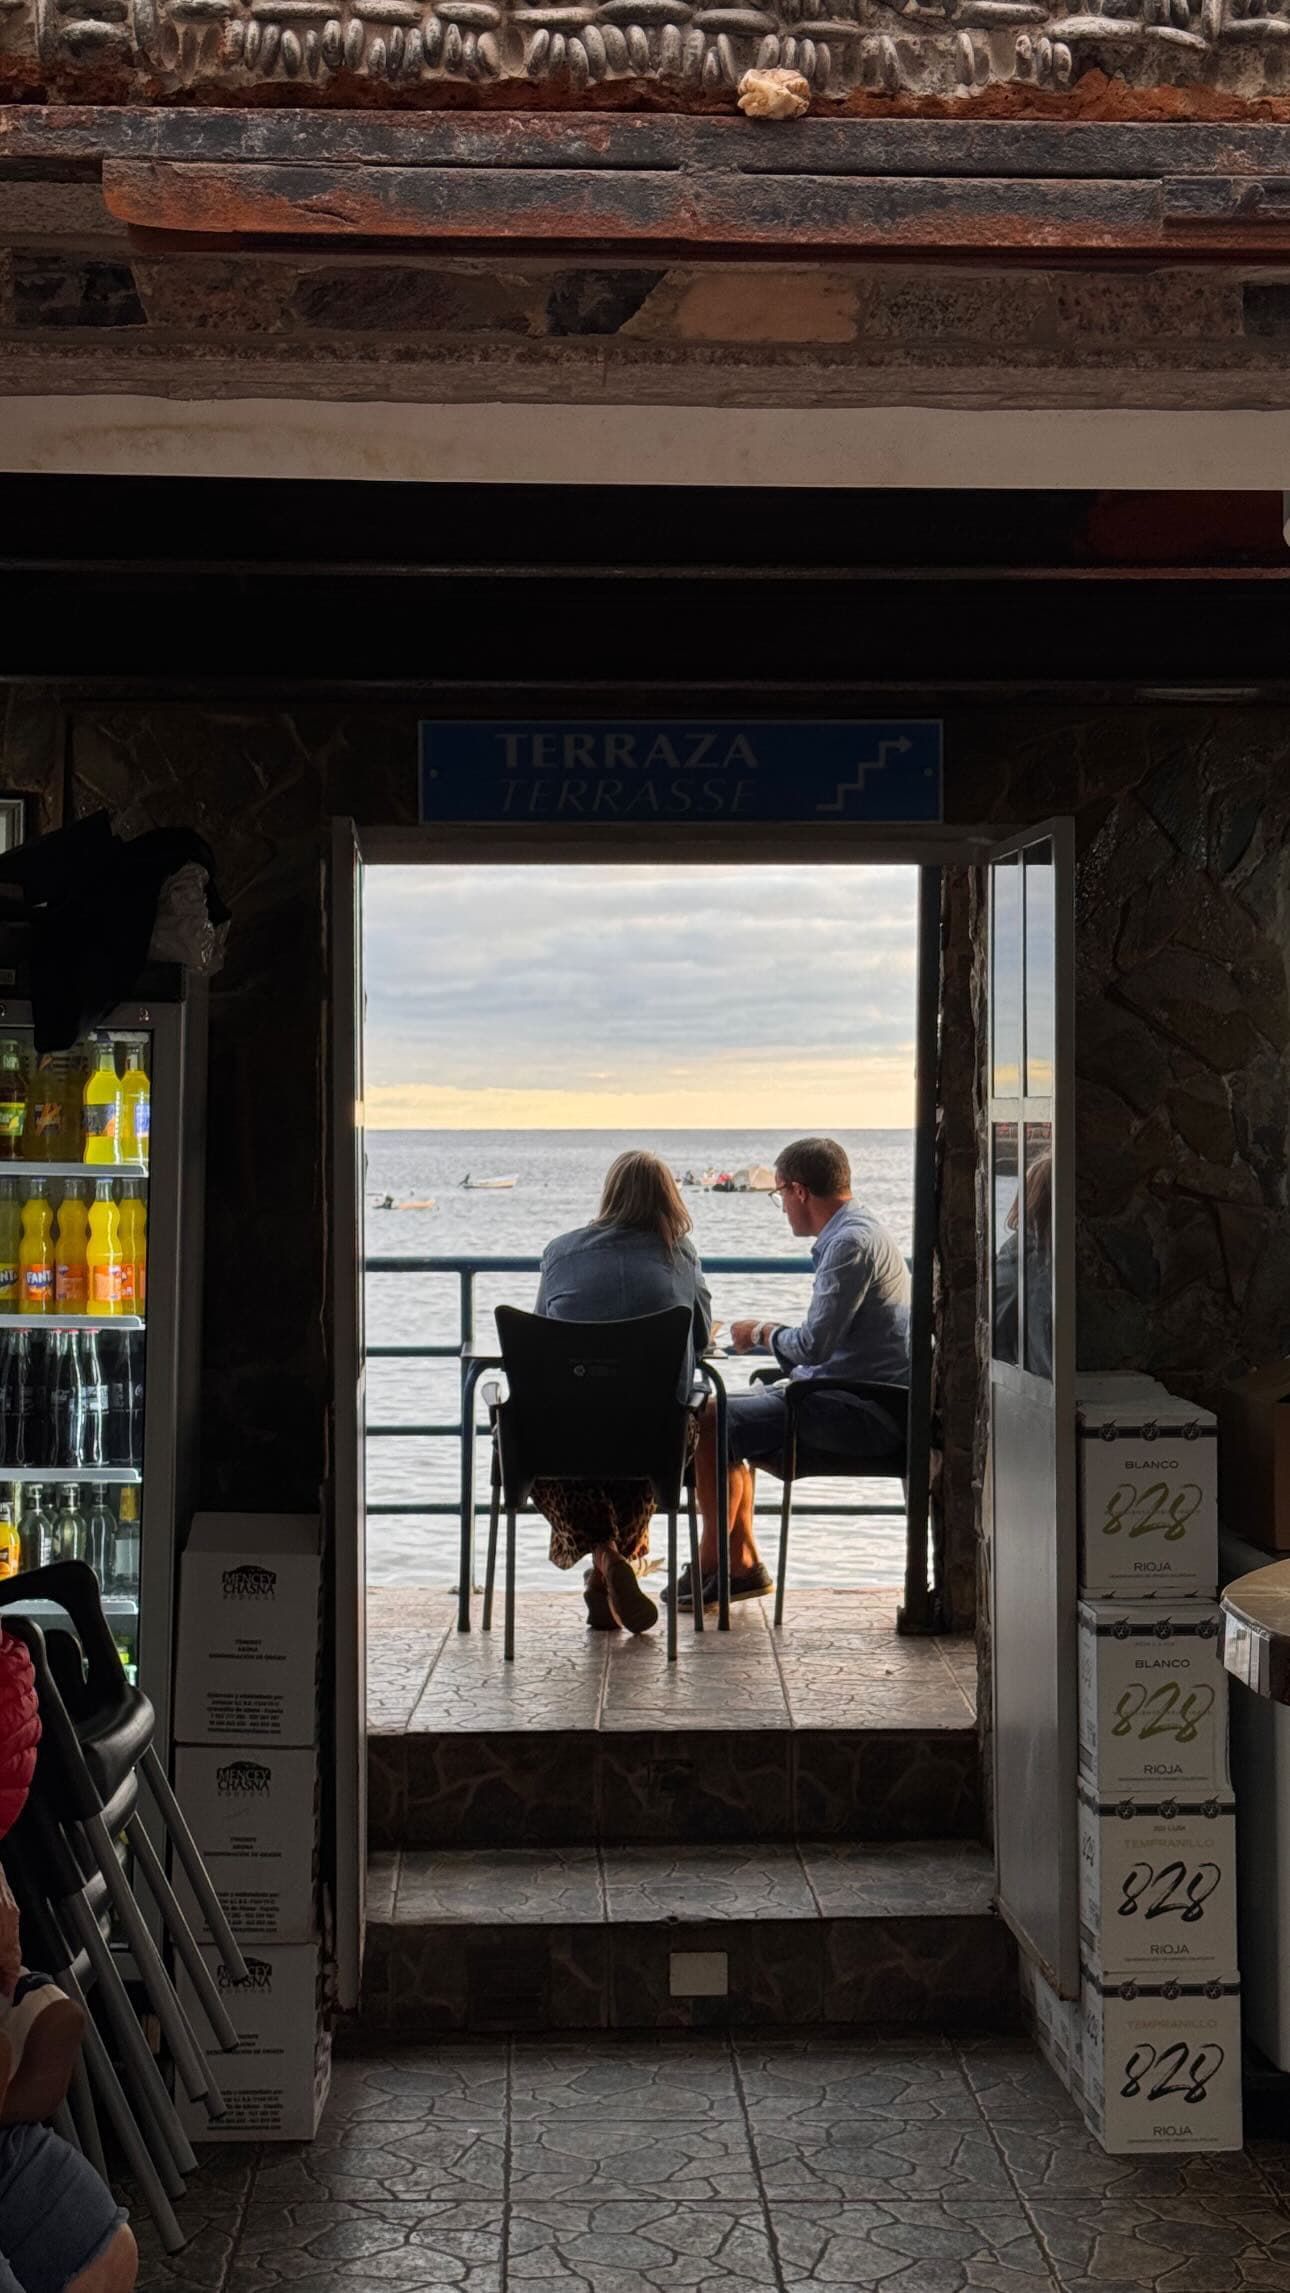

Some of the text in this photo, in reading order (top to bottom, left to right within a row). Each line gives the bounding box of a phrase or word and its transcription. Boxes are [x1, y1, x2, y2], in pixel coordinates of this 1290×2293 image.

[495, 733, 759, 768] TERRAZA
[499, 778, 760, 812] TERRASSE
[1124, 1460, 1180, 1469] BLANCO
[1101, 1481, 1203, 1541] 828
[1134, 1562, 1172, 1572] RIOJA
[223, 1572, 274, 1584] MENCEY
[223, 1583, 275, 1594] CHASNA
[1135, 1659, 1190, 1669] BLANCO
[1111, 1681, 1215, 1744] 828
[217, 1768, 270, 1780] MENCEY
[1143, 1764, 1183, 1775] RIOJA
[217, 1780, 270, 1791] CHASNA
[1124, 1838, 1215, 1849] TEMPRANILLO
[1117, 1861, 1221, 1922] 828
[1150, 1944, 1189, 1955] RIOJA
[1127, 2019, 1218, 2030] TEMPRANILLO
[1119, 2042, 1224, 2104] 828
[1153, 2126, 1192, 2136] RIOJA
